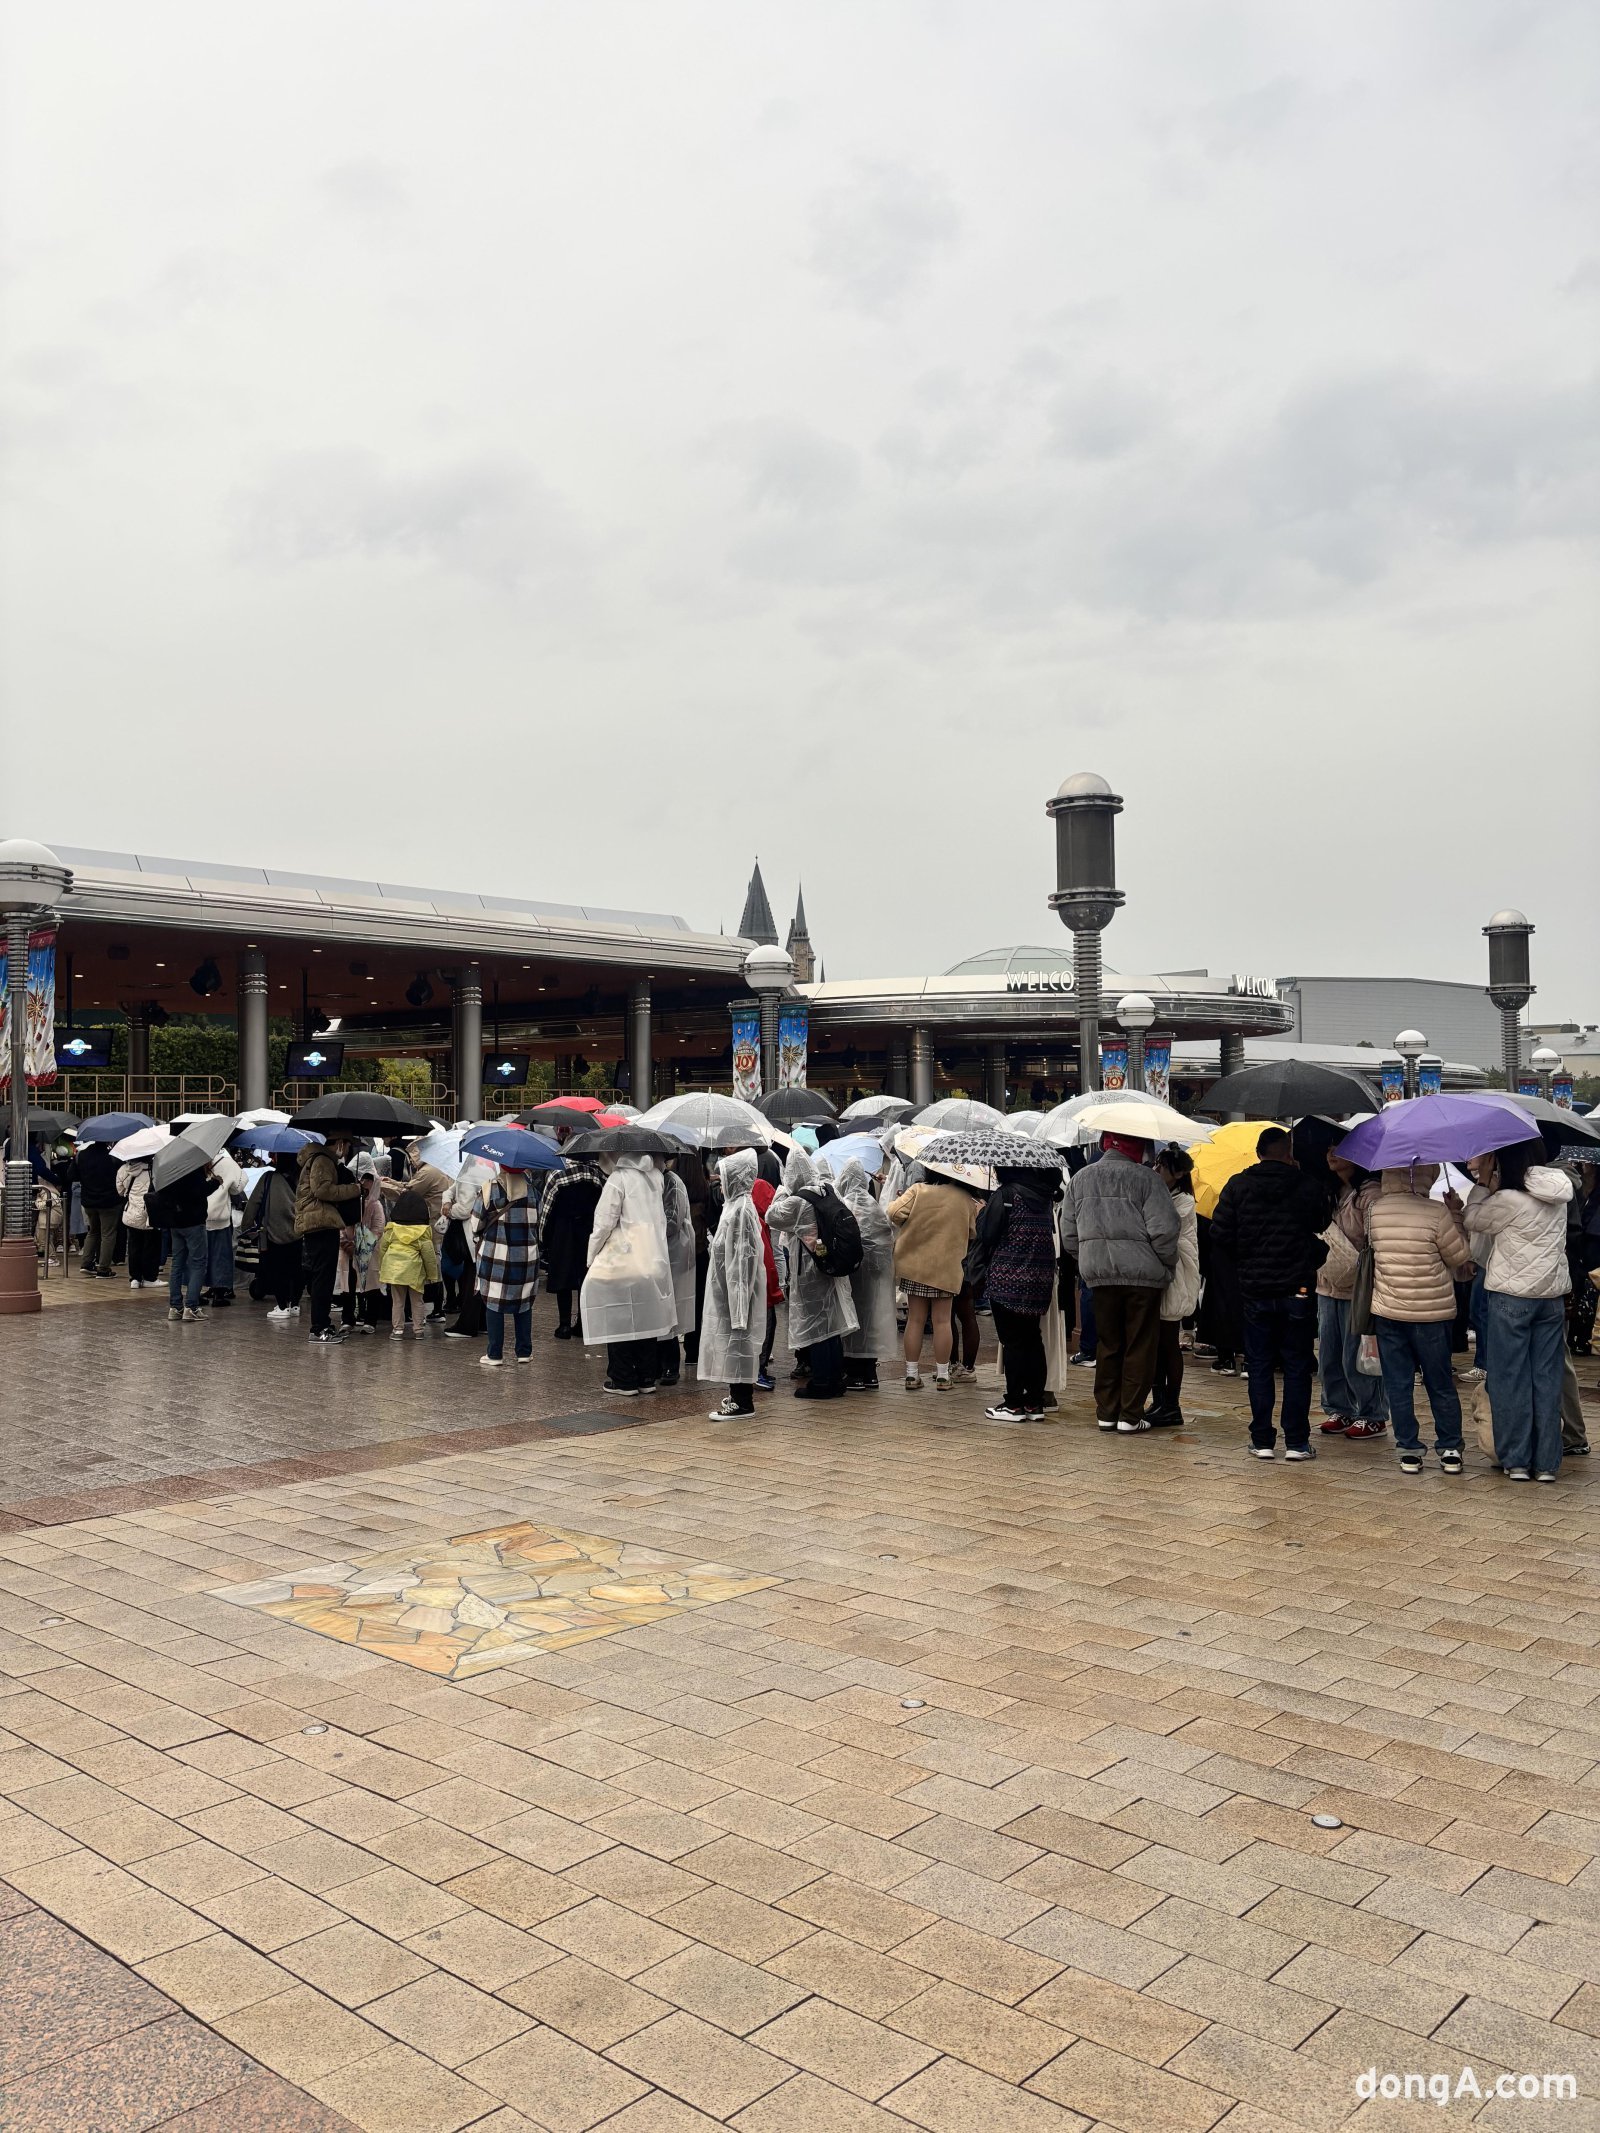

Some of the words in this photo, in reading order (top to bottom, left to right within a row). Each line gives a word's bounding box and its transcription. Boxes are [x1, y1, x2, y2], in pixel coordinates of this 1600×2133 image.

[1006, 970, 1079, 992] WELCO
[1235, 974, 1278, 998] WELCOME
[735, 1055, 757, 1068] JOY
[1105, 1076, 1125, 1087] JOY
